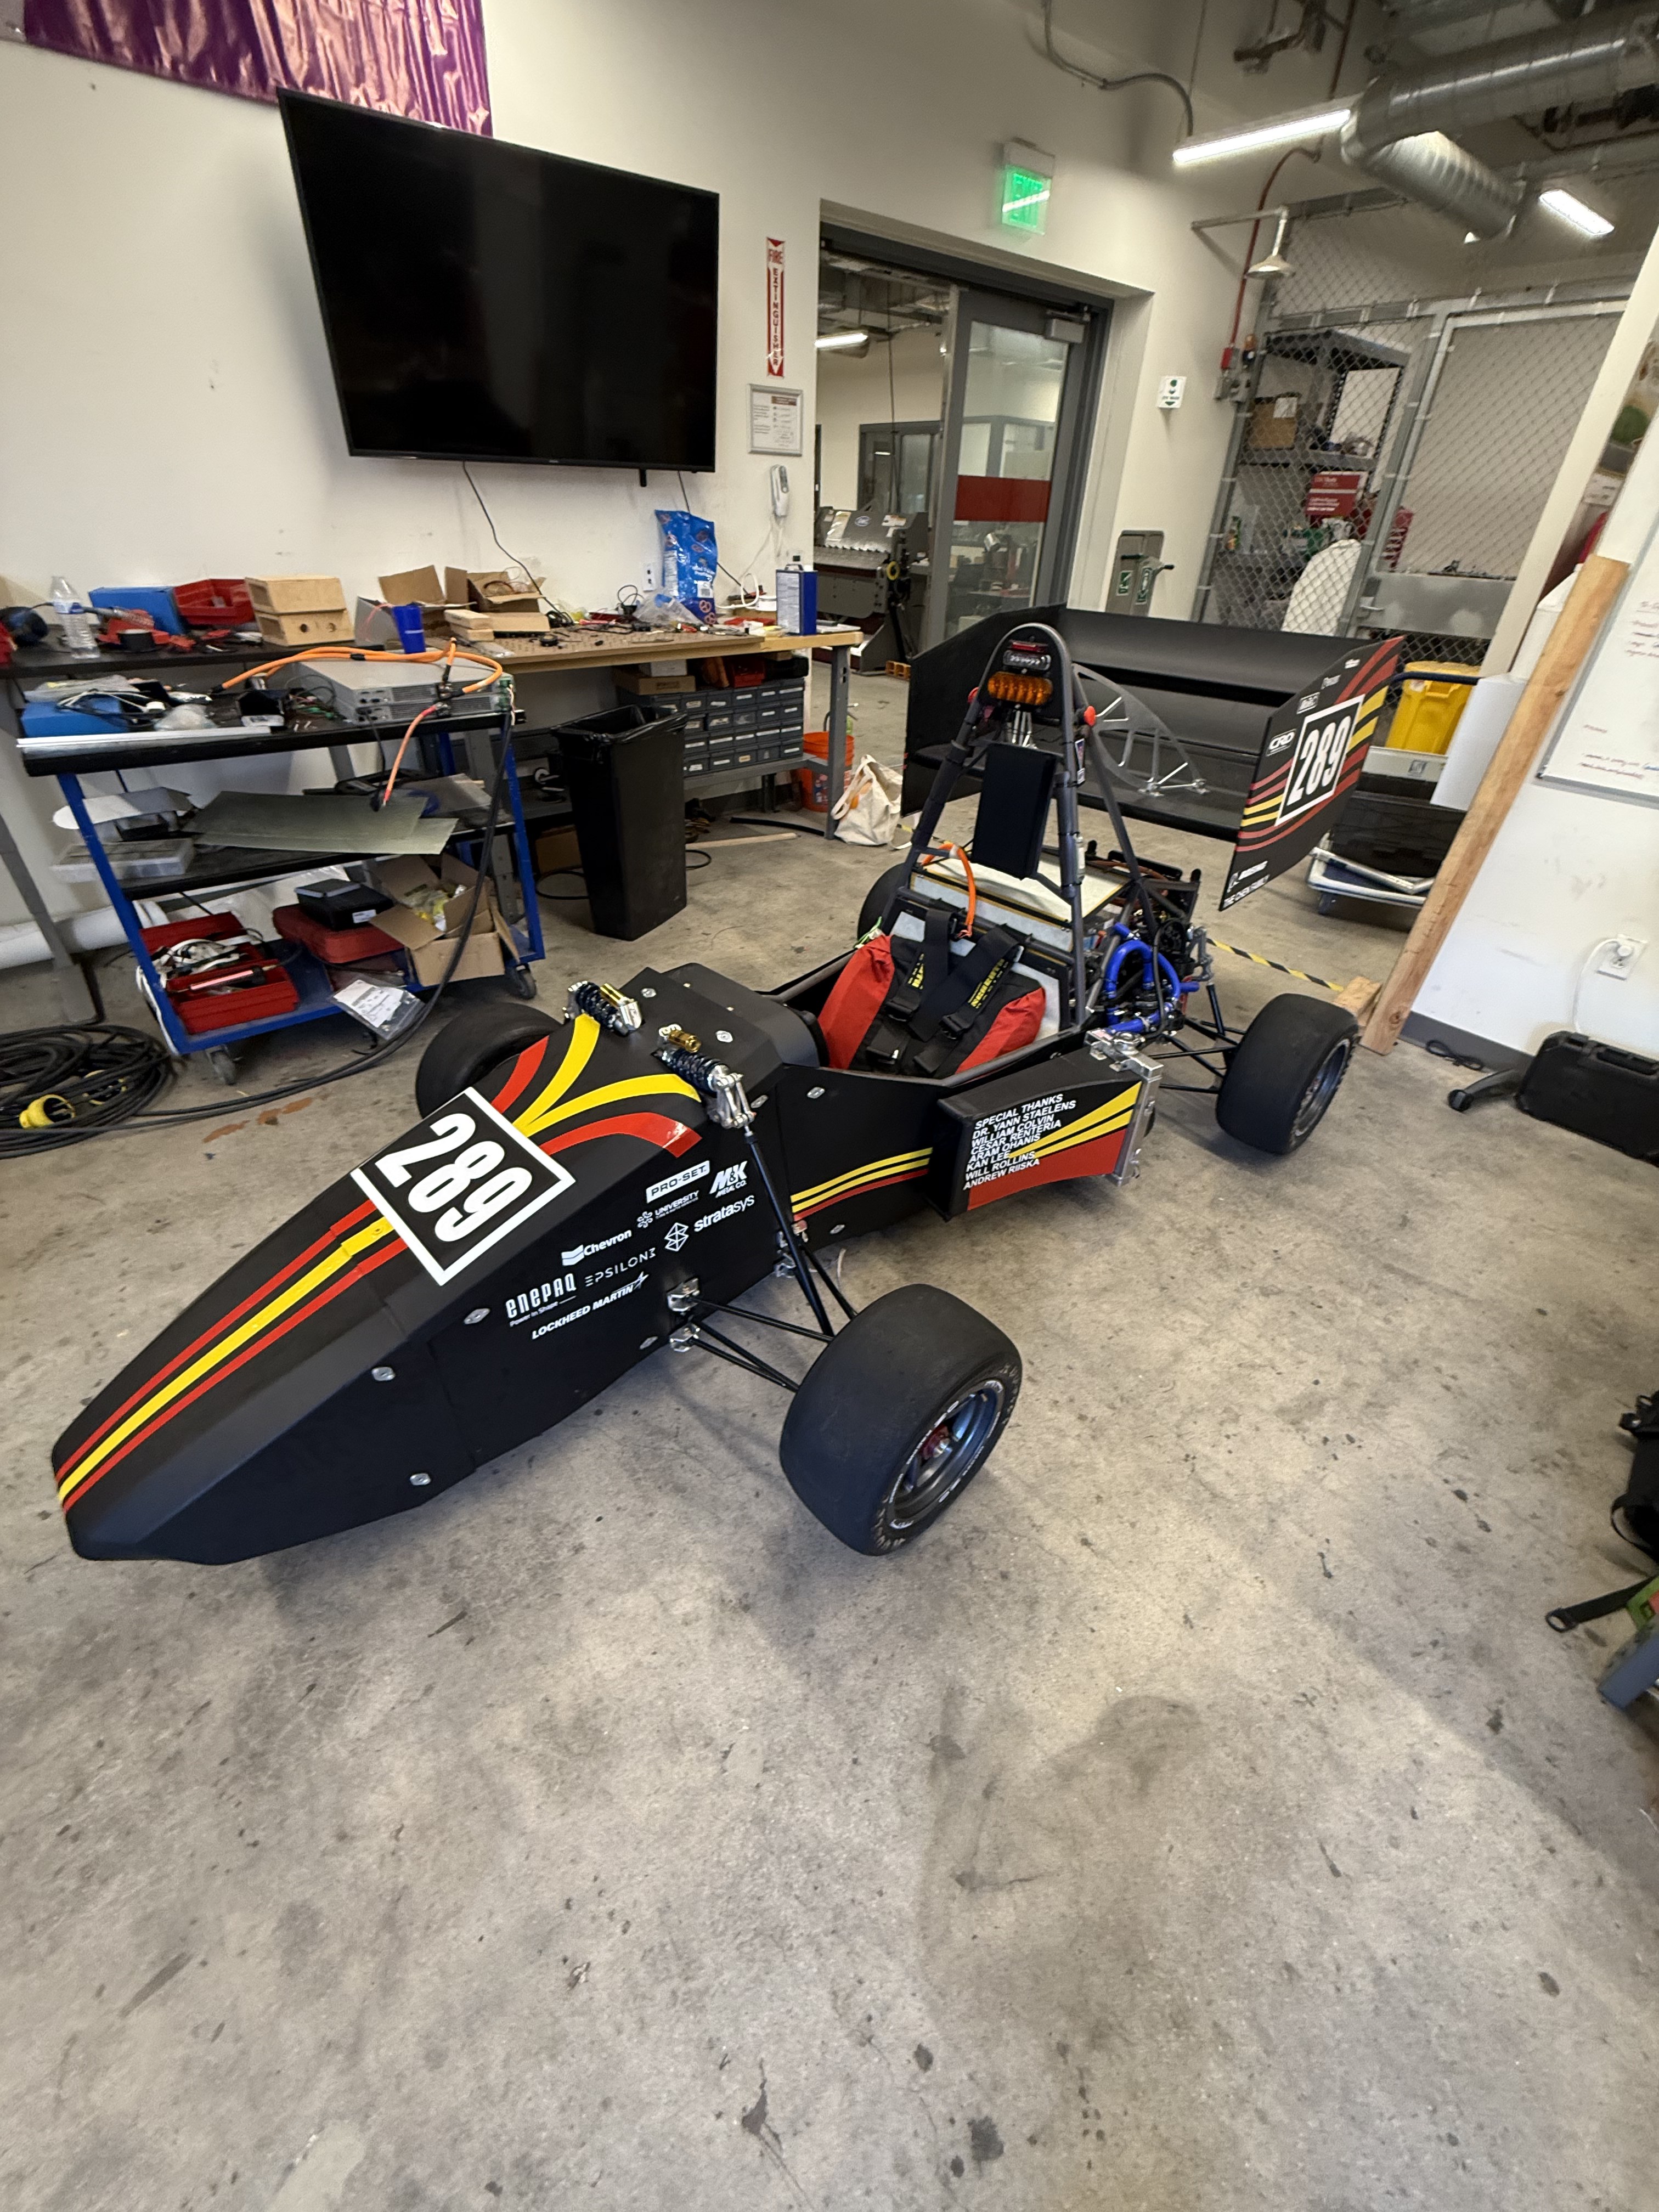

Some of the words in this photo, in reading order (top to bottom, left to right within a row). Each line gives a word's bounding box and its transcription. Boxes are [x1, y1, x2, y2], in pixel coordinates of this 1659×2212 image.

[1286, 715, 1351, 806] 289
[972, 1127, 990, 1139] DR.
[994, 1116, 1022, 1132] YANN
[1022, 1100, 1077, 1122] STAELENS
[974, 1109, 1019, 1130] SPECIAL
[1021, 1093, 1063, 1113] THANKS
[970, 1137, 1006, 1155] CESAR
[1009, 1120, 1062, 1142] RENTERIA
[972, 1127, 1015, 1148] WILLIAM
[1017, 1114, 1054, 1132] COLVIN
[966, 1158, 989, 1172] KAN
[990, 1150, 1011, 1164] LEE
[968, 1147, 1000, 1164] ARAM
[1002, 1133, 1041, 1153] OHANIS
[375, 1114, 532, 1242] 289
[709, 1161, 748, 1194] M&K
[963, 1168, 1007, 1190] ANDREW
[965, 1167, 992, 1181] WILL
[992, 1151, 1035, 1171] ROLLINS
[655, 1190, 699, 1216] UNIVERSITY
[694, 1195, 754, 1232] stratasys
[584, 1230, 632, 1256] Chevron
[532, 1306, 591, 1339] LOCKHEED
[592, 1284, 634, 1310] MARTIN
